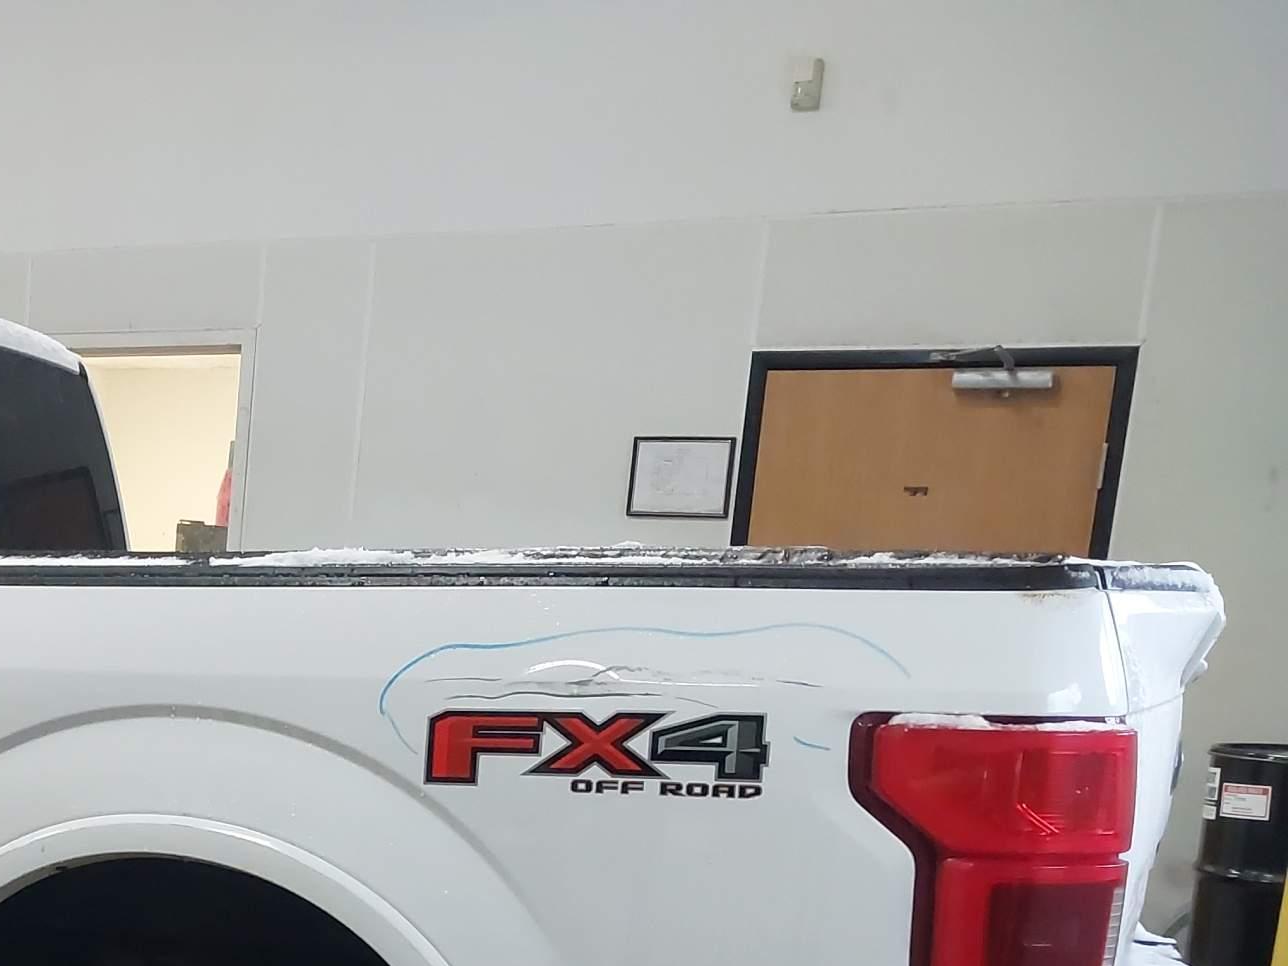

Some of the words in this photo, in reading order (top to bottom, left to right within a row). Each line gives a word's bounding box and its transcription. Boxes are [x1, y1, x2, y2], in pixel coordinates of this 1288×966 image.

[424, 709, 770, 785] FX4
[571, 779, 644, 794] OFF
[659, 782, 762, 799] ROAD
